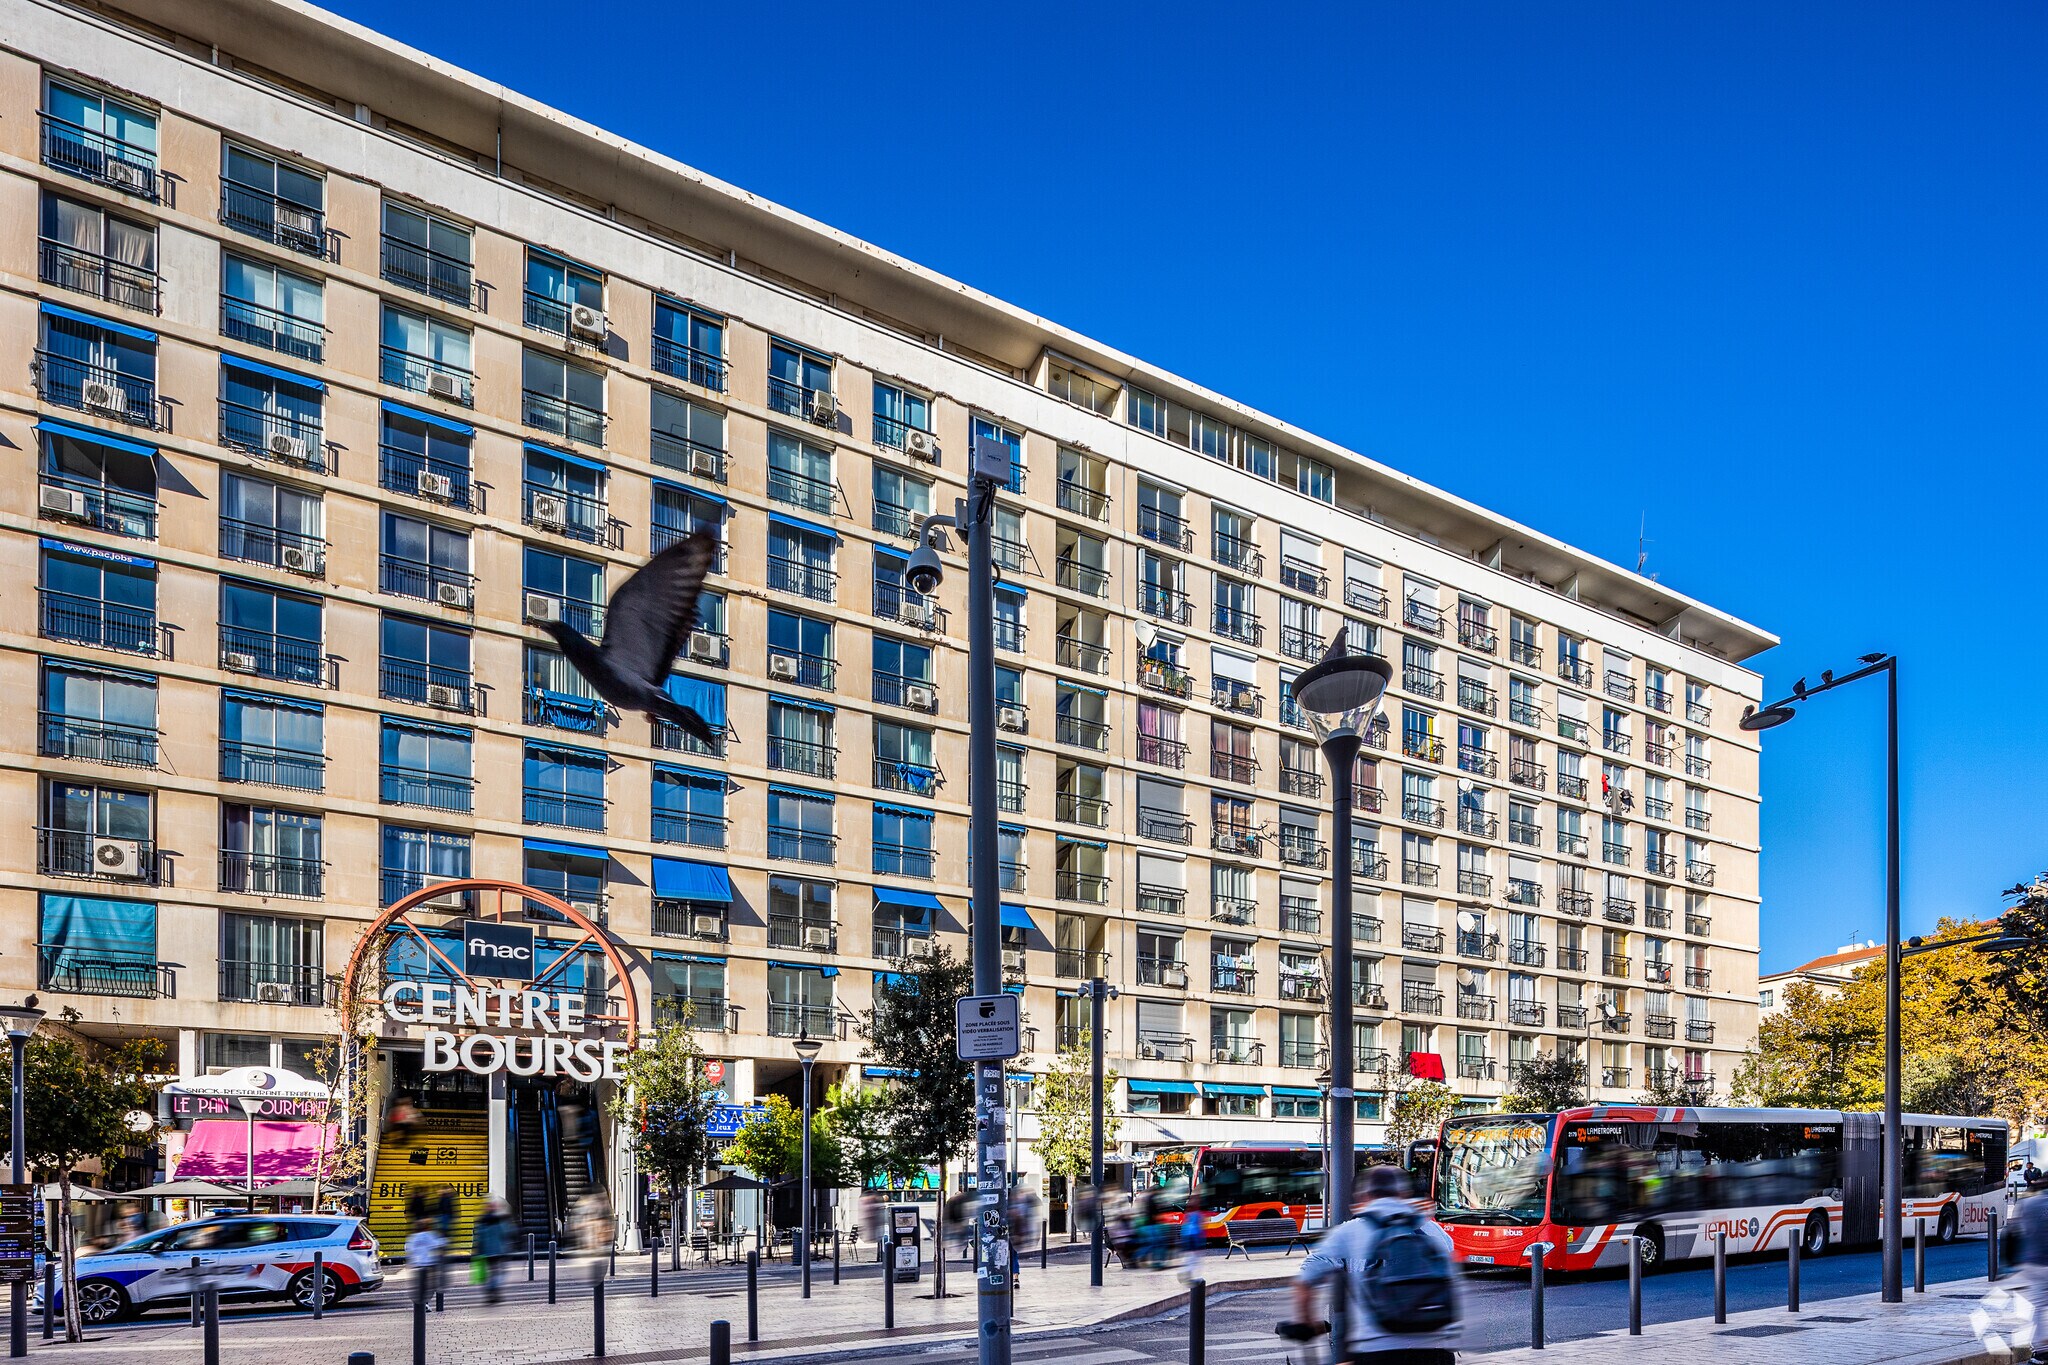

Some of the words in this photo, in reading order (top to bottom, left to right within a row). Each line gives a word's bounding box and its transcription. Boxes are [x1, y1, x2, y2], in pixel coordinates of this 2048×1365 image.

[385, 829, 470, 847] 04.91.91.26.42
[468, 938, 531, 960] fnac
[383, 980, 585, 1033] CENTRE
[422, 1031, 629, 1083] BOURSE
[173, 1097, 191, 1113] LE
[198, 1097, 229, 1114] PAIN
[259, 1099, 332, 1116] OURMAND
[380, 1183, 484, 1197] BIENUE
